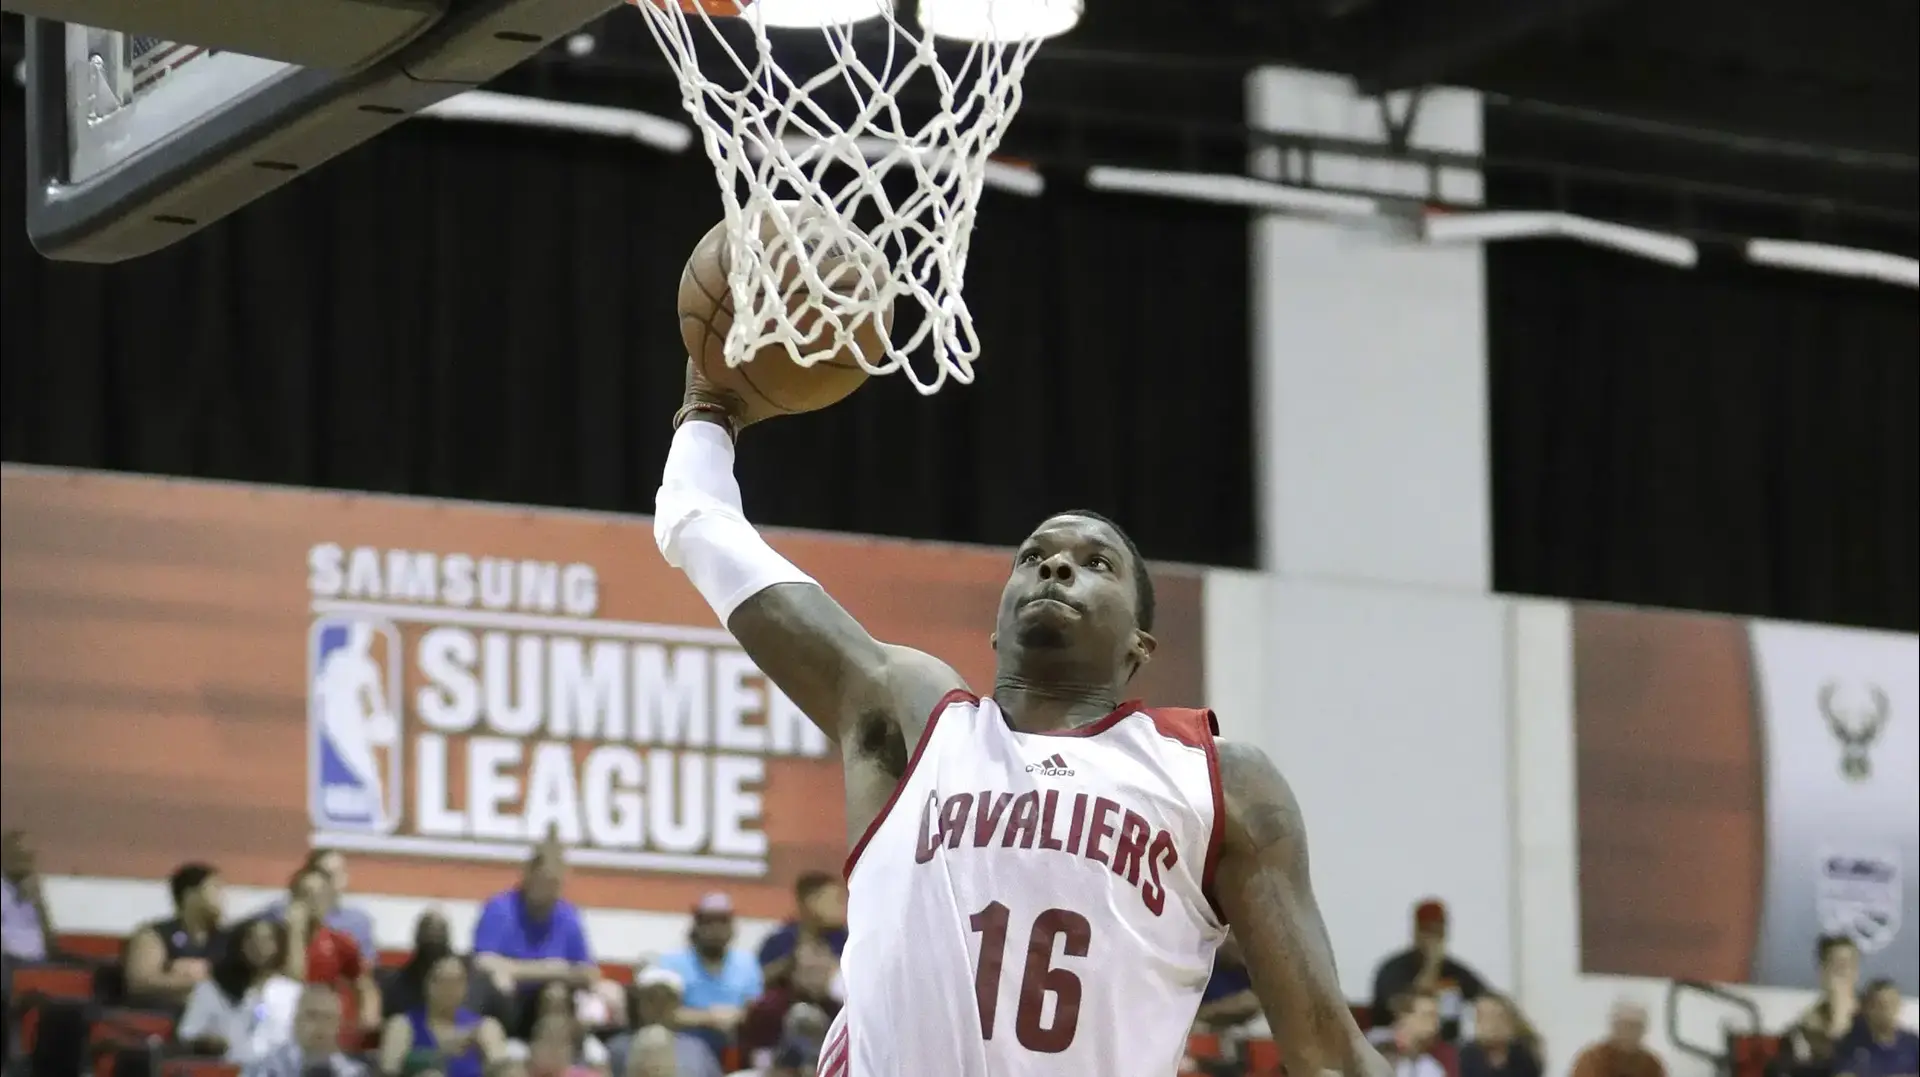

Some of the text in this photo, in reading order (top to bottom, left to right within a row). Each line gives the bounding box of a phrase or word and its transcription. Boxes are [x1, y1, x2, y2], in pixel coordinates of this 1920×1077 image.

[308, 542, 598, 616] SAMSUNG
[415, 732, 769, 857] LEAGUE
[915, 789, 1178, 917] CAVALIERS
[970, 900, 1091, 1053] 16
